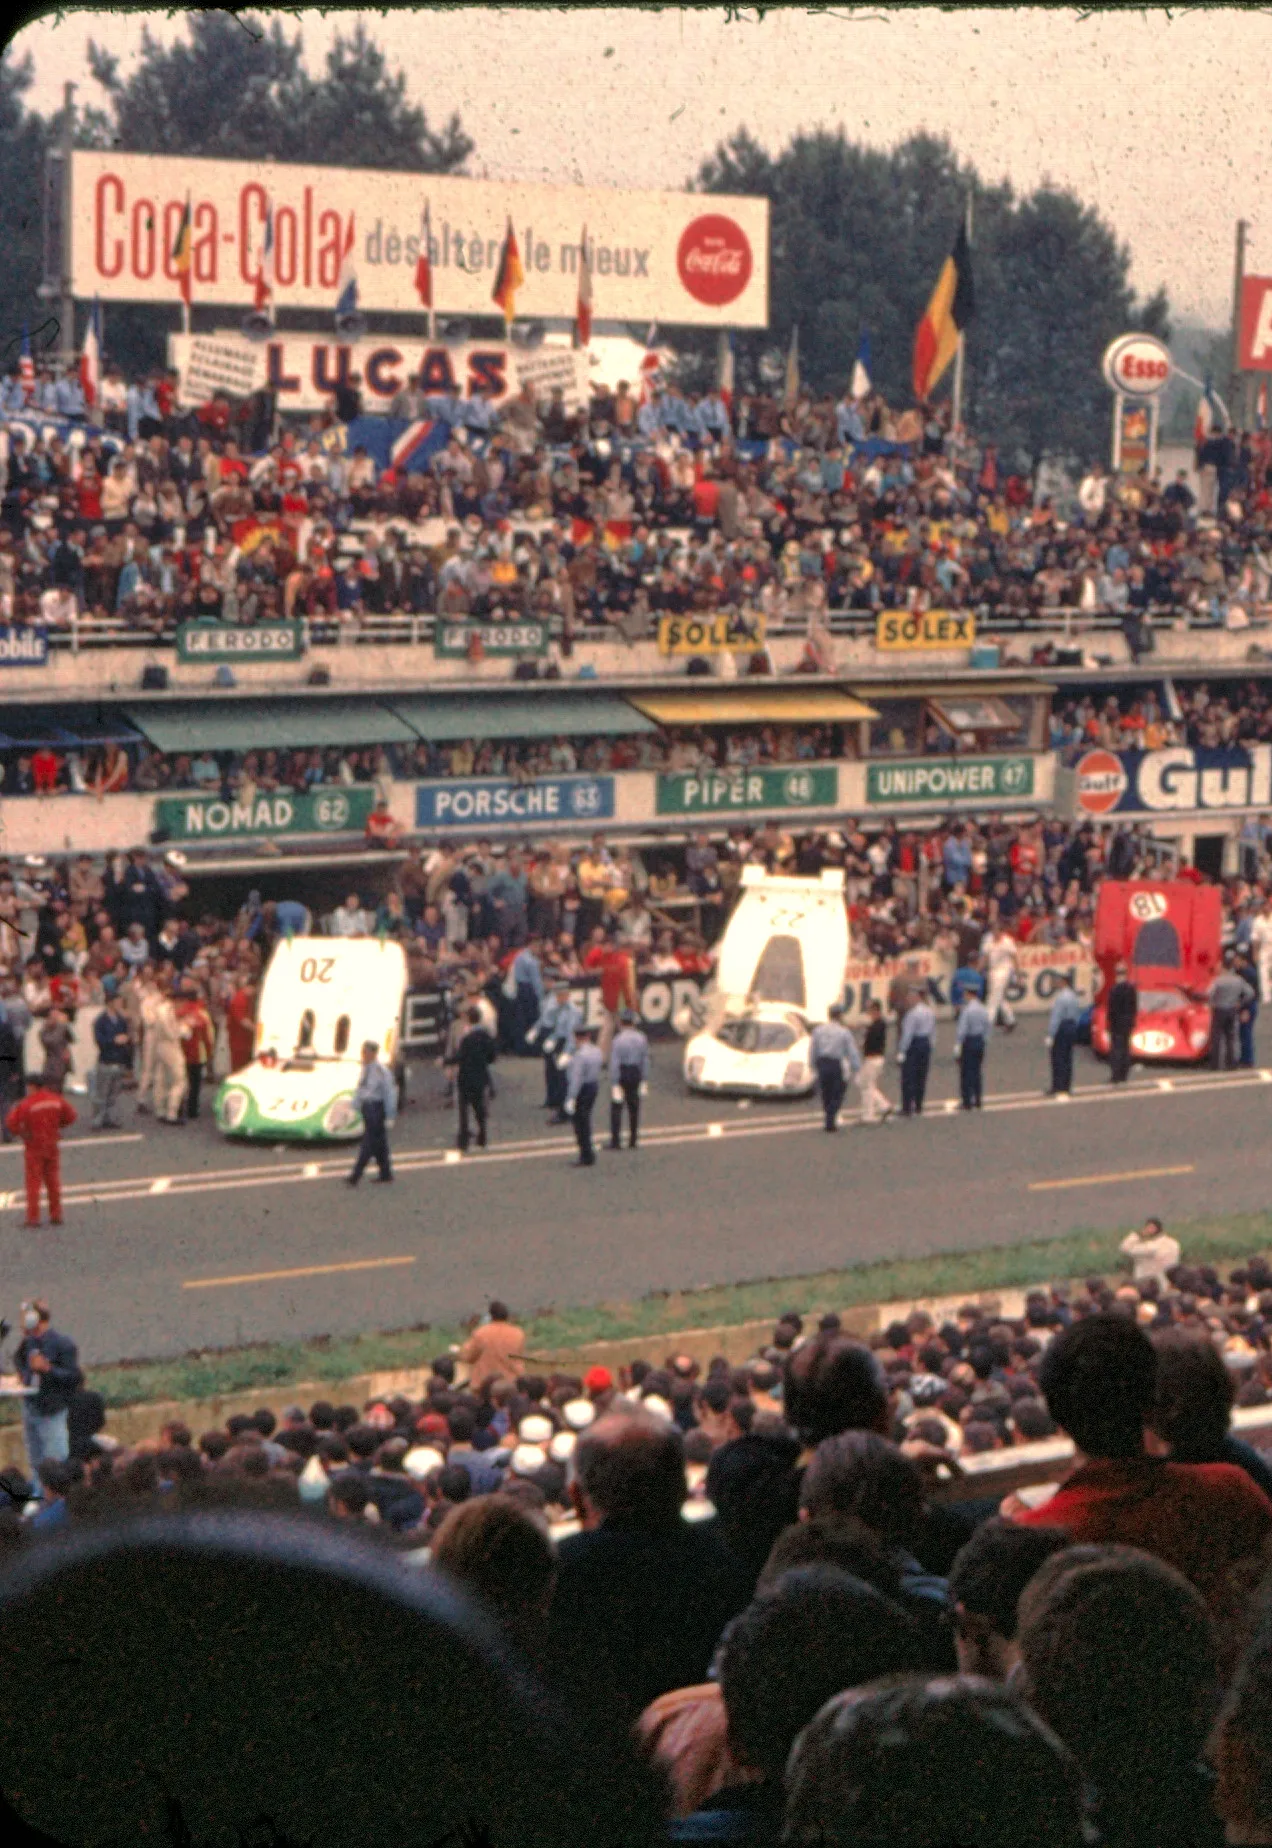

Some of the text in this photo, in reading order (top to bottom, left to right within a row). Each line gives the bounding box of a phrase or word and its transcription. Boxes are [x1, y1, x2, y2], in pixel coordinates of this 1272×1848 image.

[95, 173, 343, 290] Coca-Cola
[365, 216, 502, 273] désaltèr
[525, 226, 551, 274] le
[266, 342, 507, 399] LUCAS
[1122, 353, 1169, 379] Esso
[0, 628, 44, 658] obile
[189, 629, 293, 651] FERODO
[885, 617, 968, 642] SOLEX
[683, 775, 763, 806] PIPER
[879, 765, 1023, 796] UNIPOWER 47
[1080, 777, 1121, 792] Gulf
[186, 799, 345, 833] NOMAD 62
[435, 786, 560, 819] PORSCHE
[300, 957, 336, 984] 20
